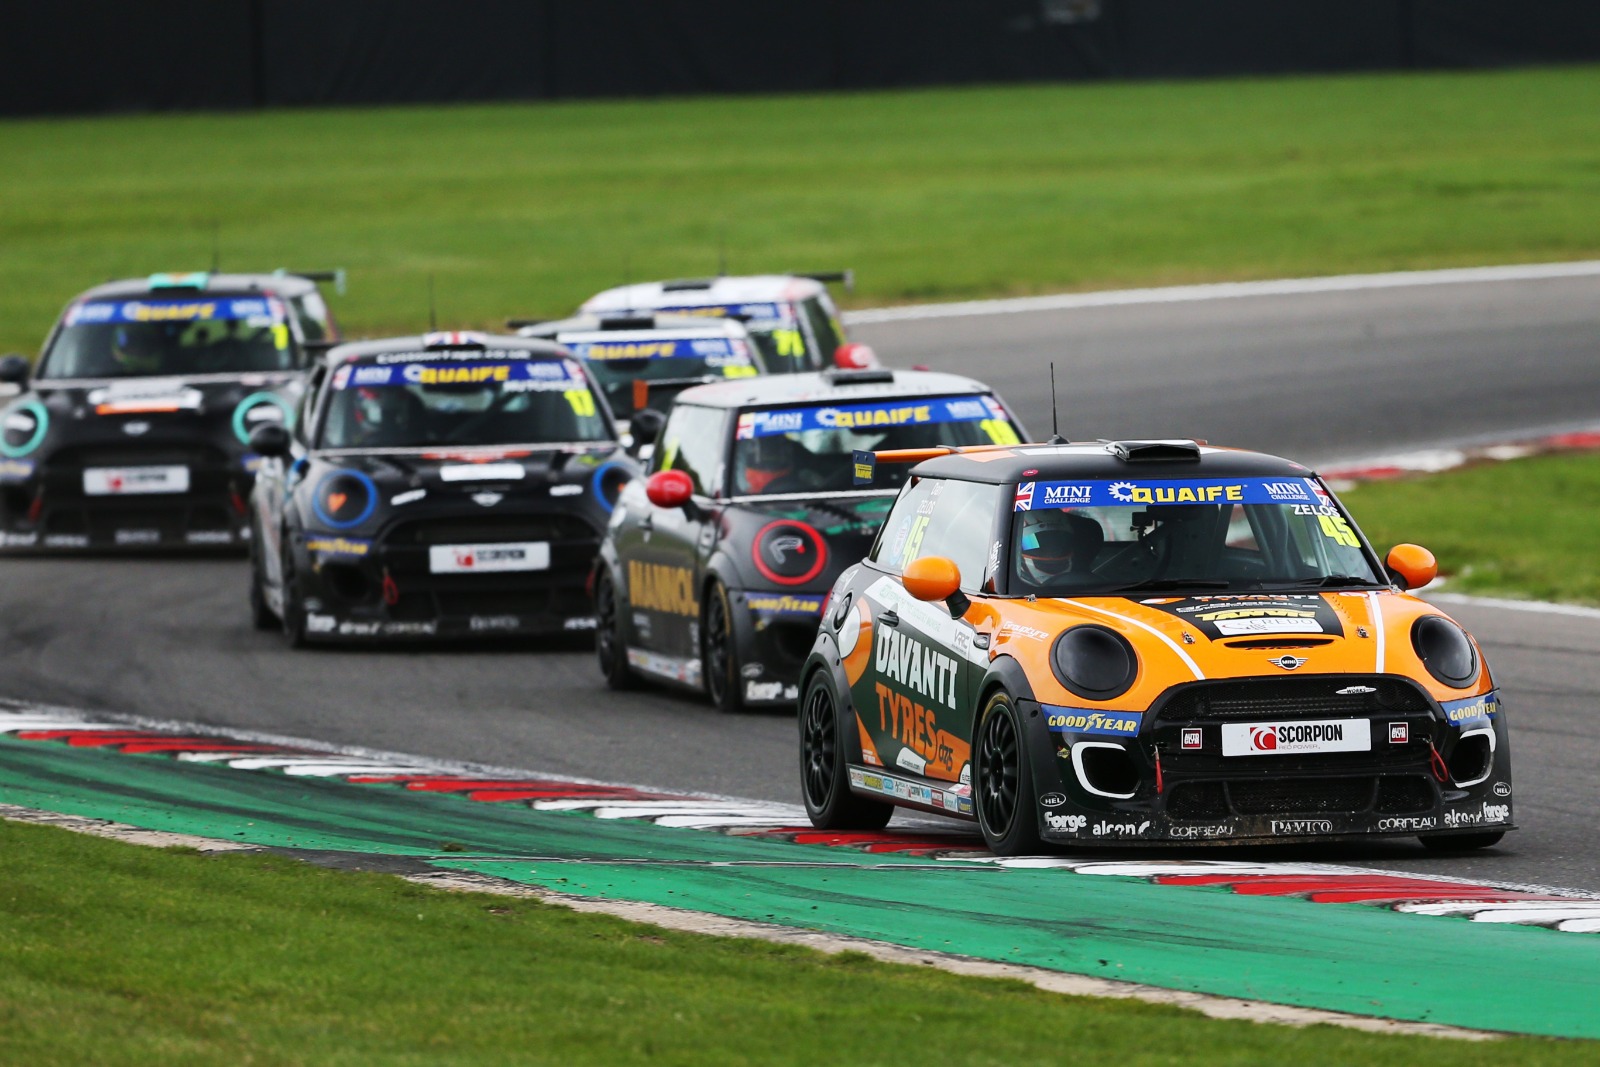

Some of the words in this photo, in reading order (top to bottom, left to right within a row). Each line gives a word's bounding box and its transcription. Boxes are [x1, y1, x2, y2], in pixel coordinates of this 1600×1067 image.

[420, 366, 511, 384] QUAIFE
[834, 405, 930, 428] QUAIFE
[1045, 486, 1092, 499] MINI
[1131, 484, 1244, 504] QUAIFE
[1262, 482, 1307, 496] MINI
[1270, 493, 1311, 501] CHALLENGE
[1044, 496, 1092, 504] CHALLENGE
[1291, 504, 1340, 518] ZELOS
[1317, 515, 1362, 549] 45
[875, 622, 958, 711] DAVANTI
[875, 681, 937, 761] TYRES
[1278, 724, 1343, 743] SCORPION
[1044, 797, 1061, 805] HEL
[1482, 801, 1510, 822] forge
[1044, 811, 1088, 833] forge
